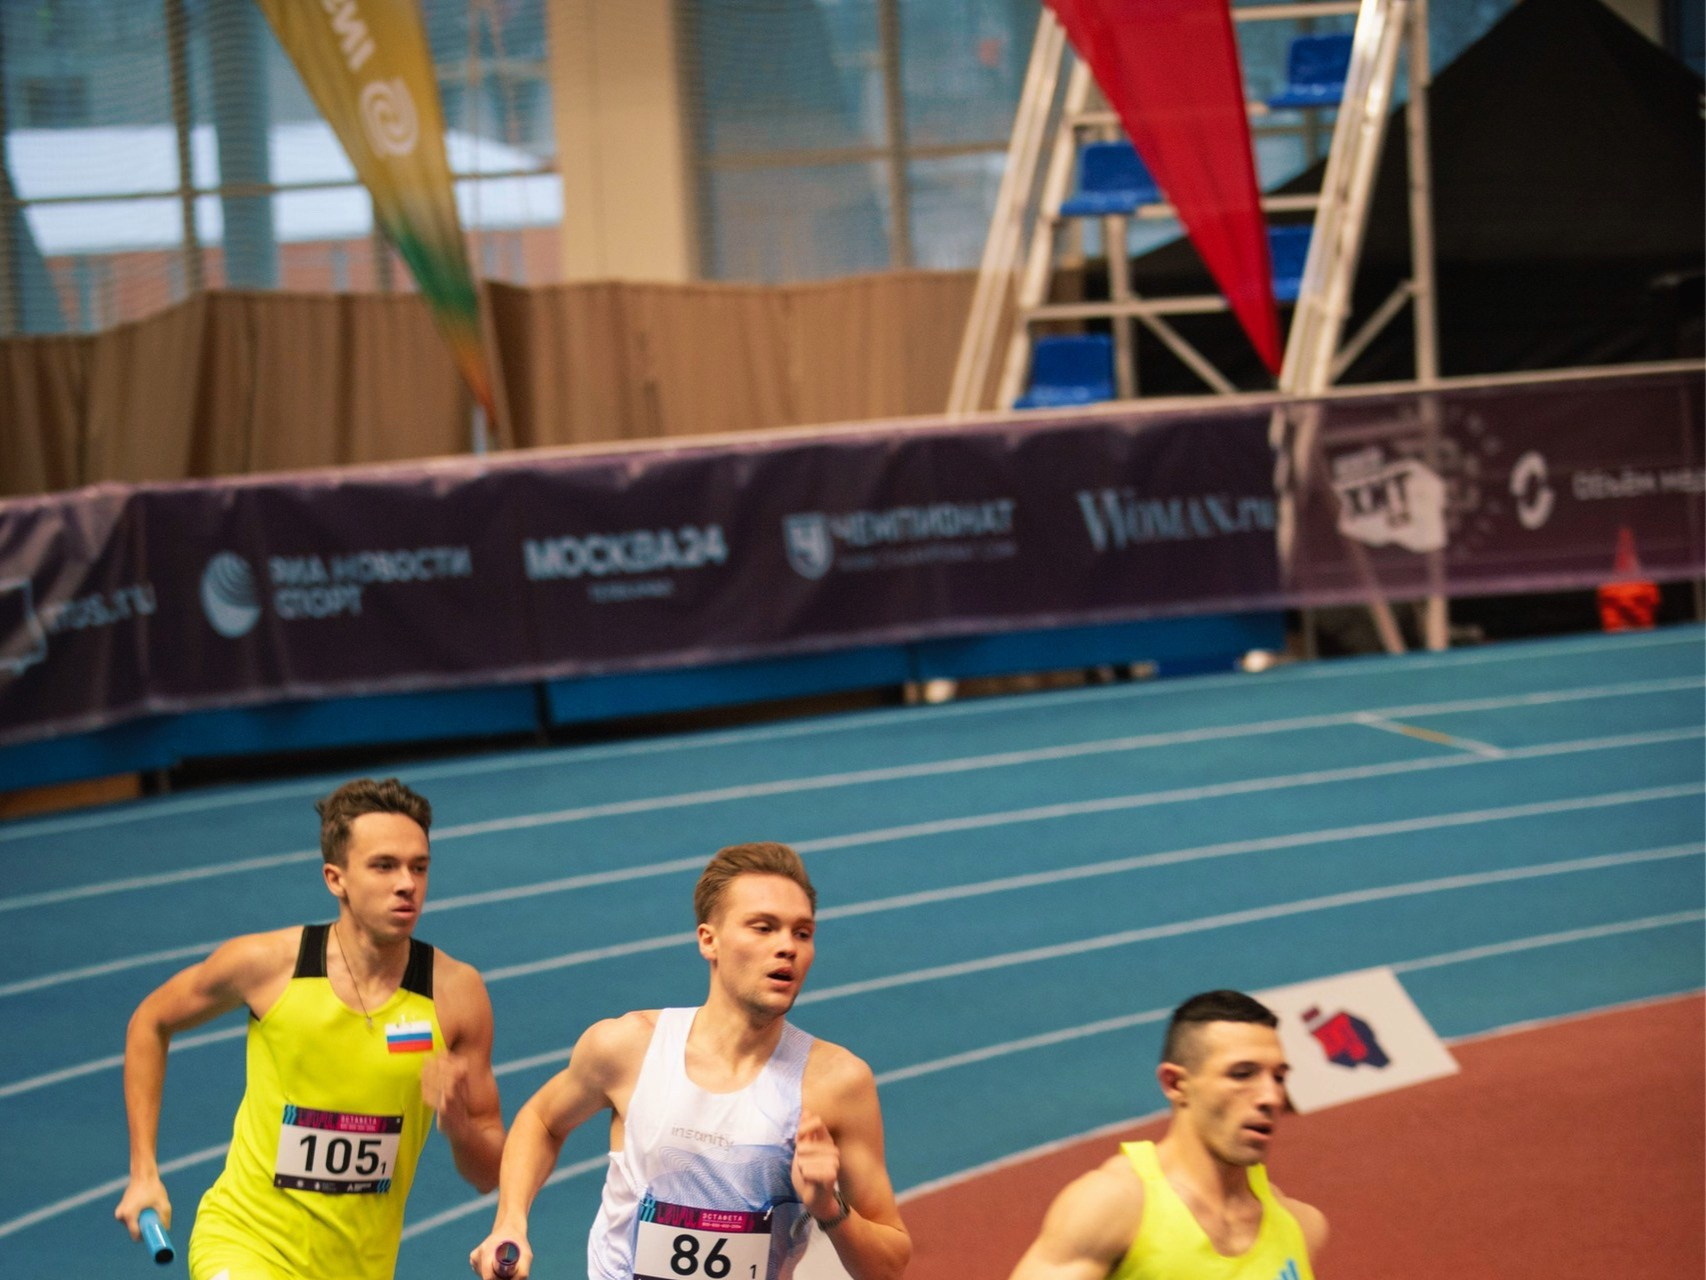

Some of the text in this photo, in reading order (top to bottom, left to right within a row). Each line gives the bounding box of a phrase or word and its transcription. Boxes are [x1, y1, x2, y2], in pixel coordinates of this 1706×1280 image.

[523, 524, 728, 581] МОСКВА24
[299, 1133, 387, 1176] 105 1
[670, 1233, 757, 1279] 86 1
